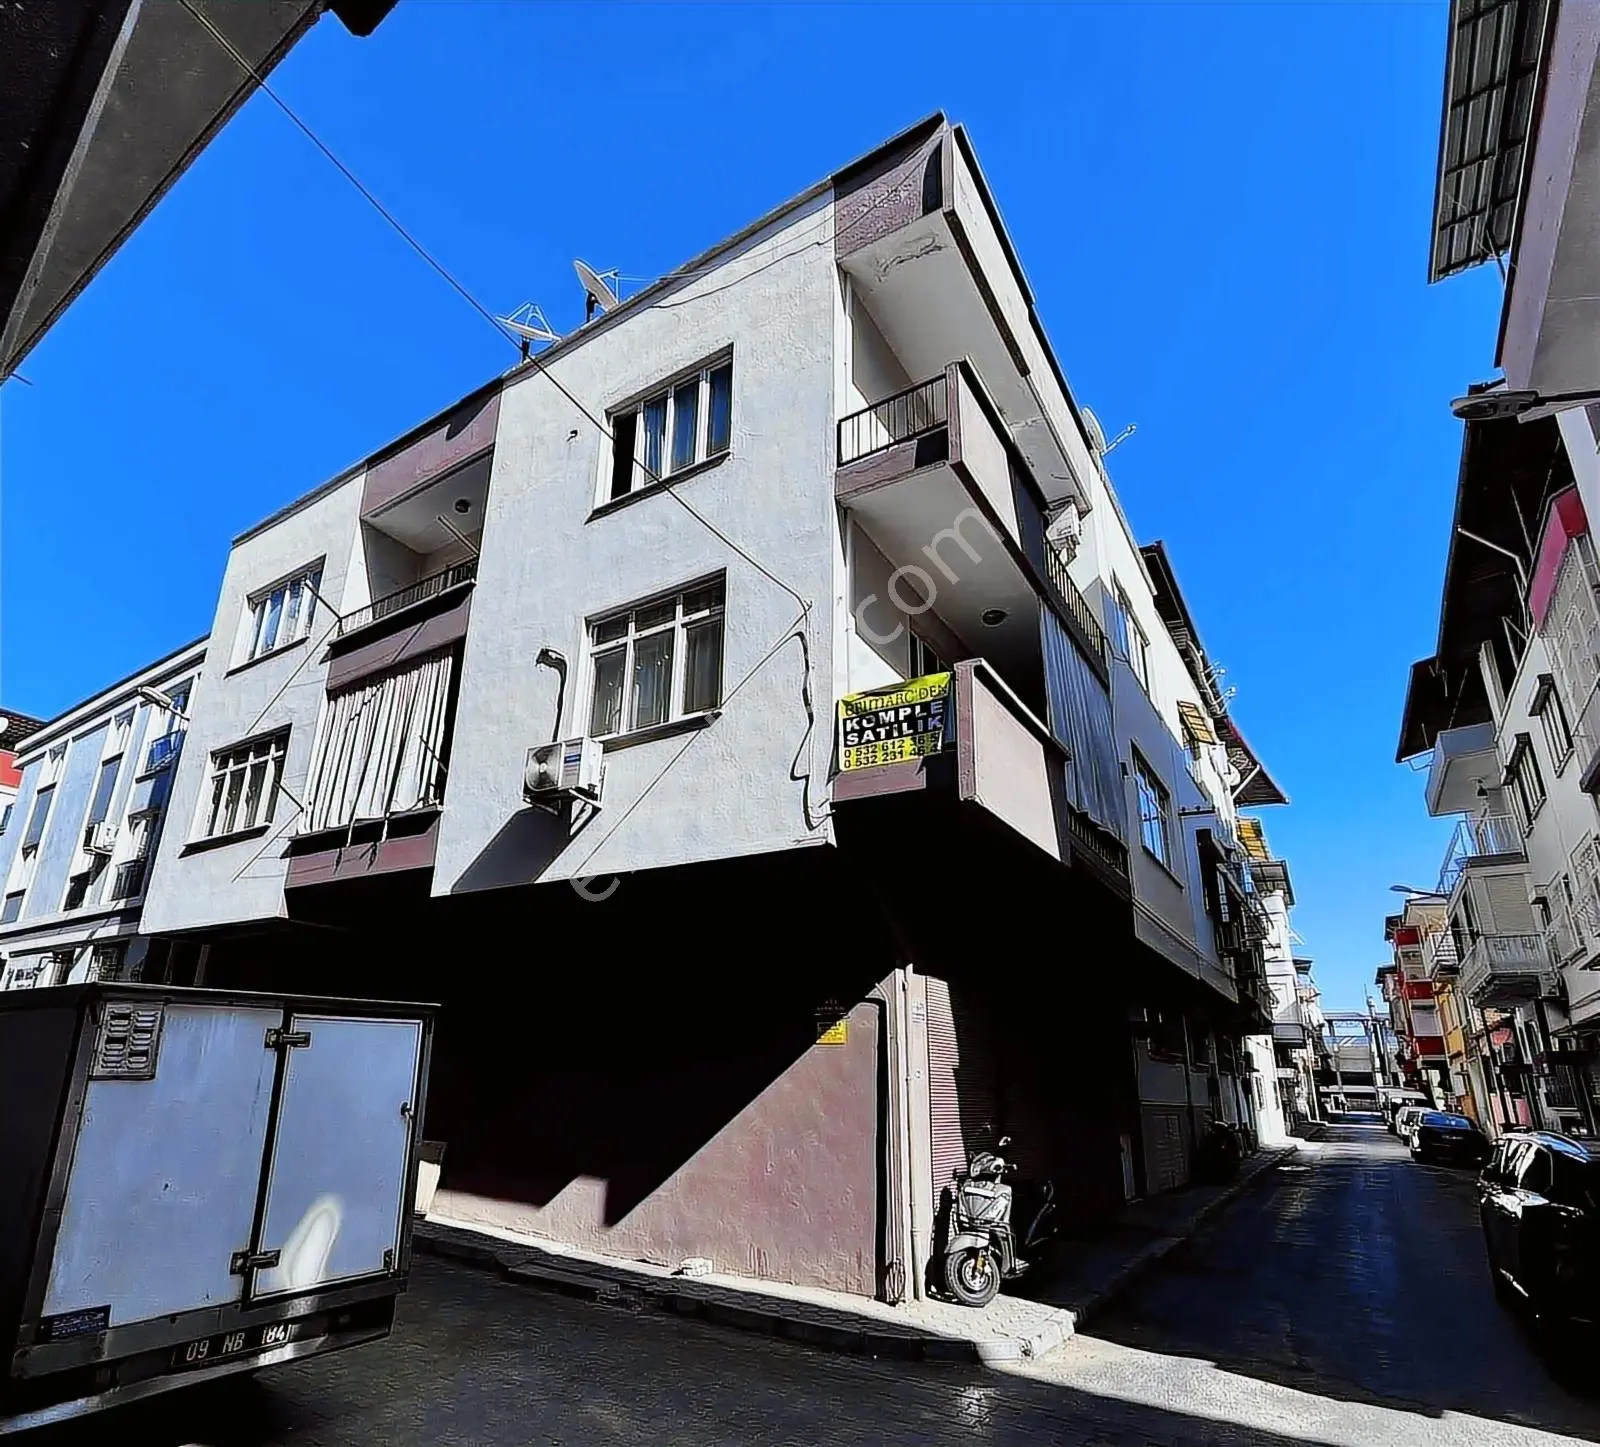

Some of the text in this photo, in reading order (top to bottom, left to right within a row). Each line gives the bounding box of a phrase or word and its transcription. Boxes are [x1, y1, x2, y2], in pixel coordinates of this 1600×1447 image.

[846, 700, 944, 732] KOMPLE
[844, 749, 852, 759] 0
[855, 744, 878, 757] 532
[881, 739, 905, 752] 612
[844, 759, 852, 769] 0
[855, 754, 878, 765] 532
[881, 750, 904, 761] 231
[186, 1339, 209, 1361] 09
